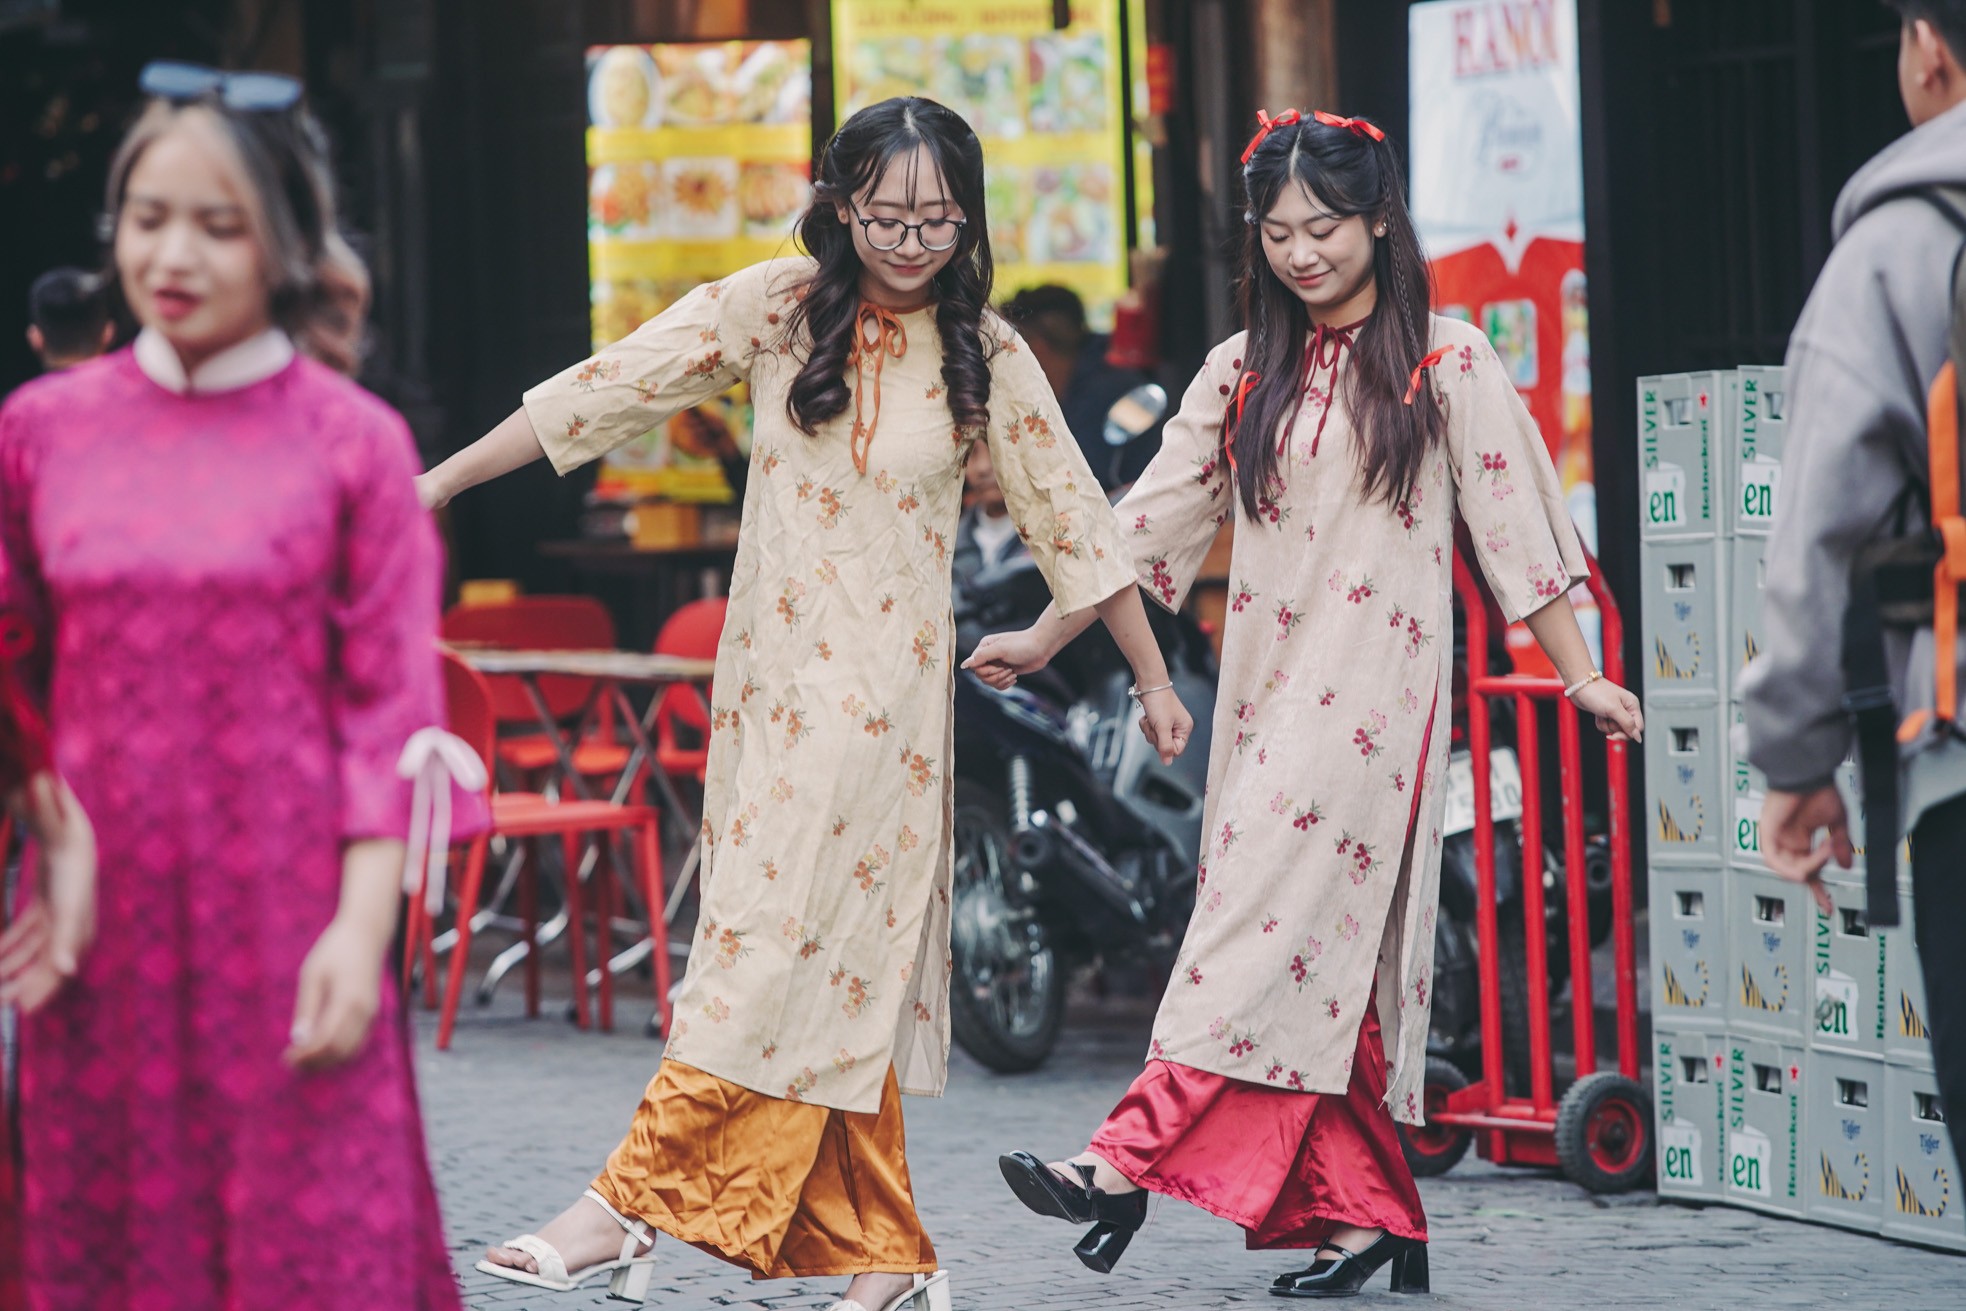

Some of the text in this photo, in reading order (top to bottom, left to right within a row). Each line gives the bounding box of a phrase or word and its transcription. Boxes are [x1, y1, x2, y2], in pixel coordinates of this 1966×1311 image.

[1645, 390, 1658, 469] SILVER
[1743, 379, 1757, 460] SILVER
[1816, 908, 1830, 975] SILVE
[1876, 932, 1886, 1039] Heineken
[1660, 1042, 1673, 1122] SILVER
[1731, 1048, 1744, 1129] SILVER
